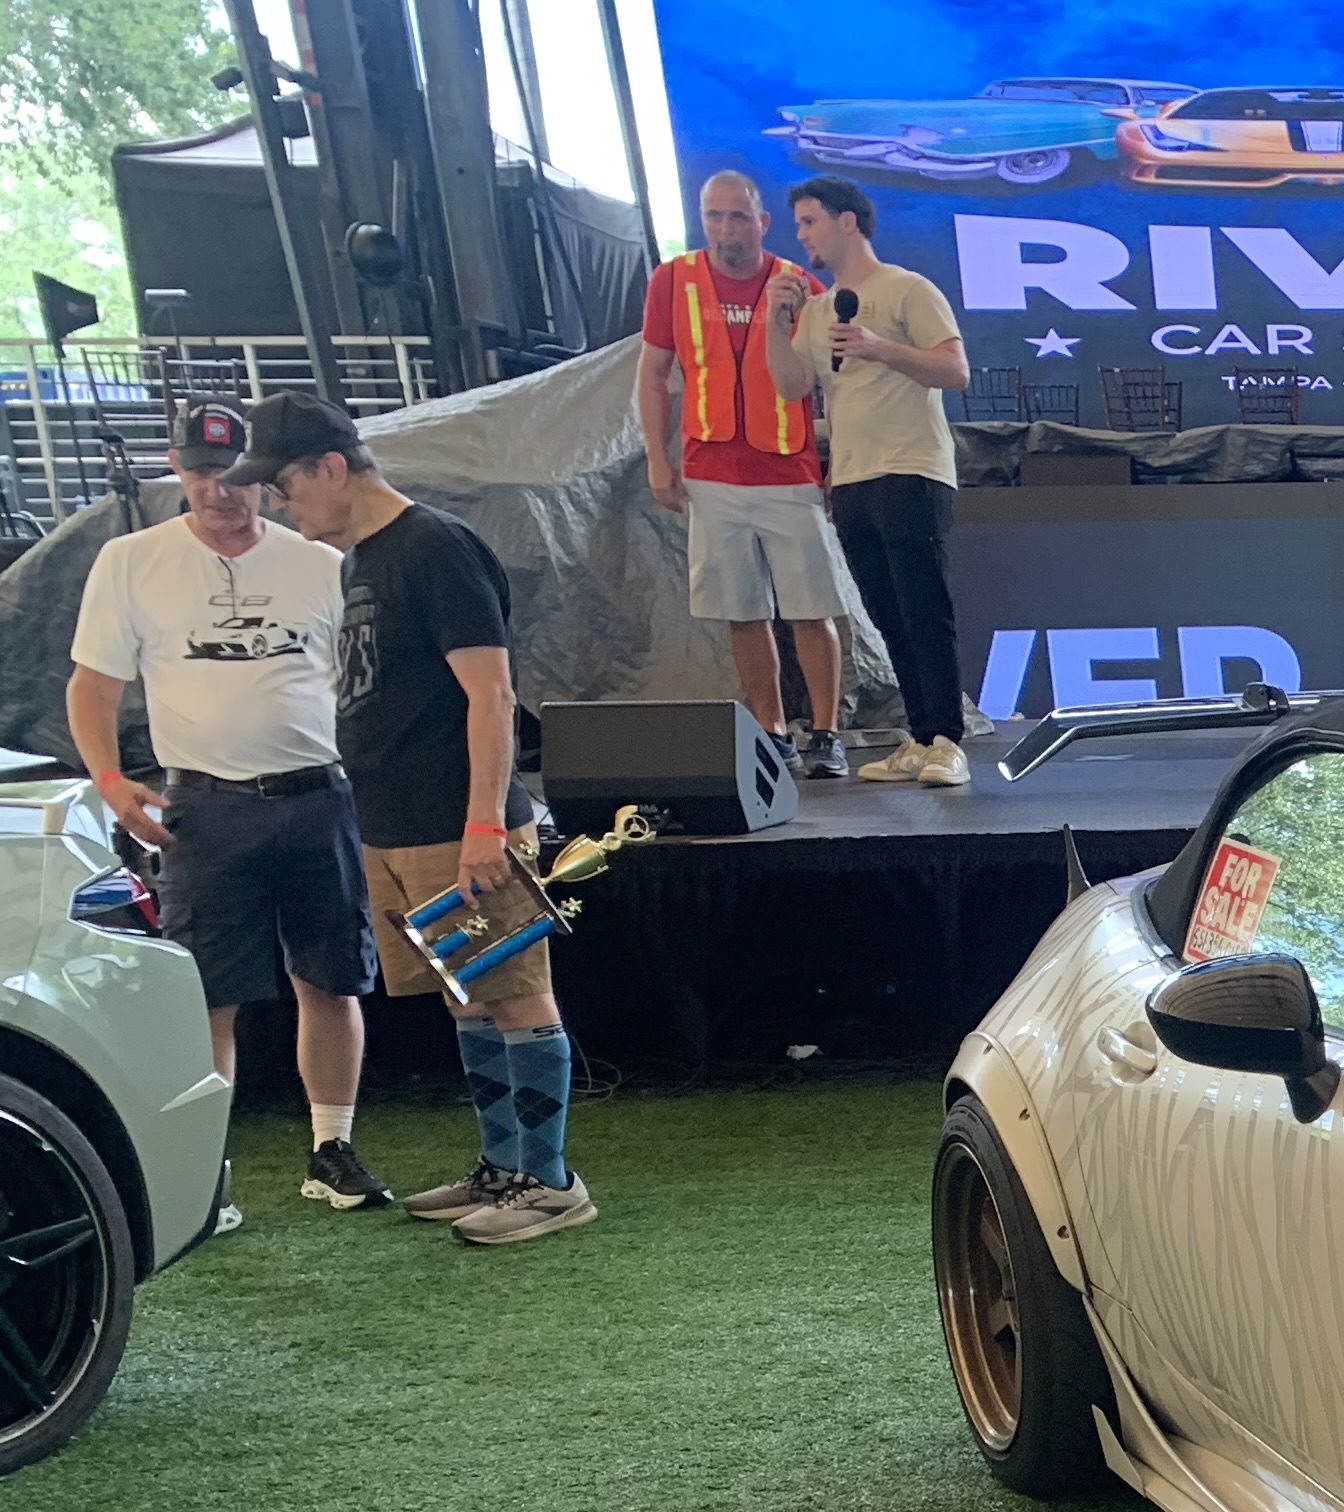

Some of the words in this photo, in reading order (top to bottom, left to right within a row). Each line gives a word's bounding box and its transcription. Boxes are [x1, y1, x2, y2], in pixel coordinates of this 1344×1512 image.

[1151, 323, 1314, 355] CAR
[1221, 375, 1333, 390] TAMPA
[1218, 853, 1263, 899] FOR
[1201, 886, 1259, 940] SALE
